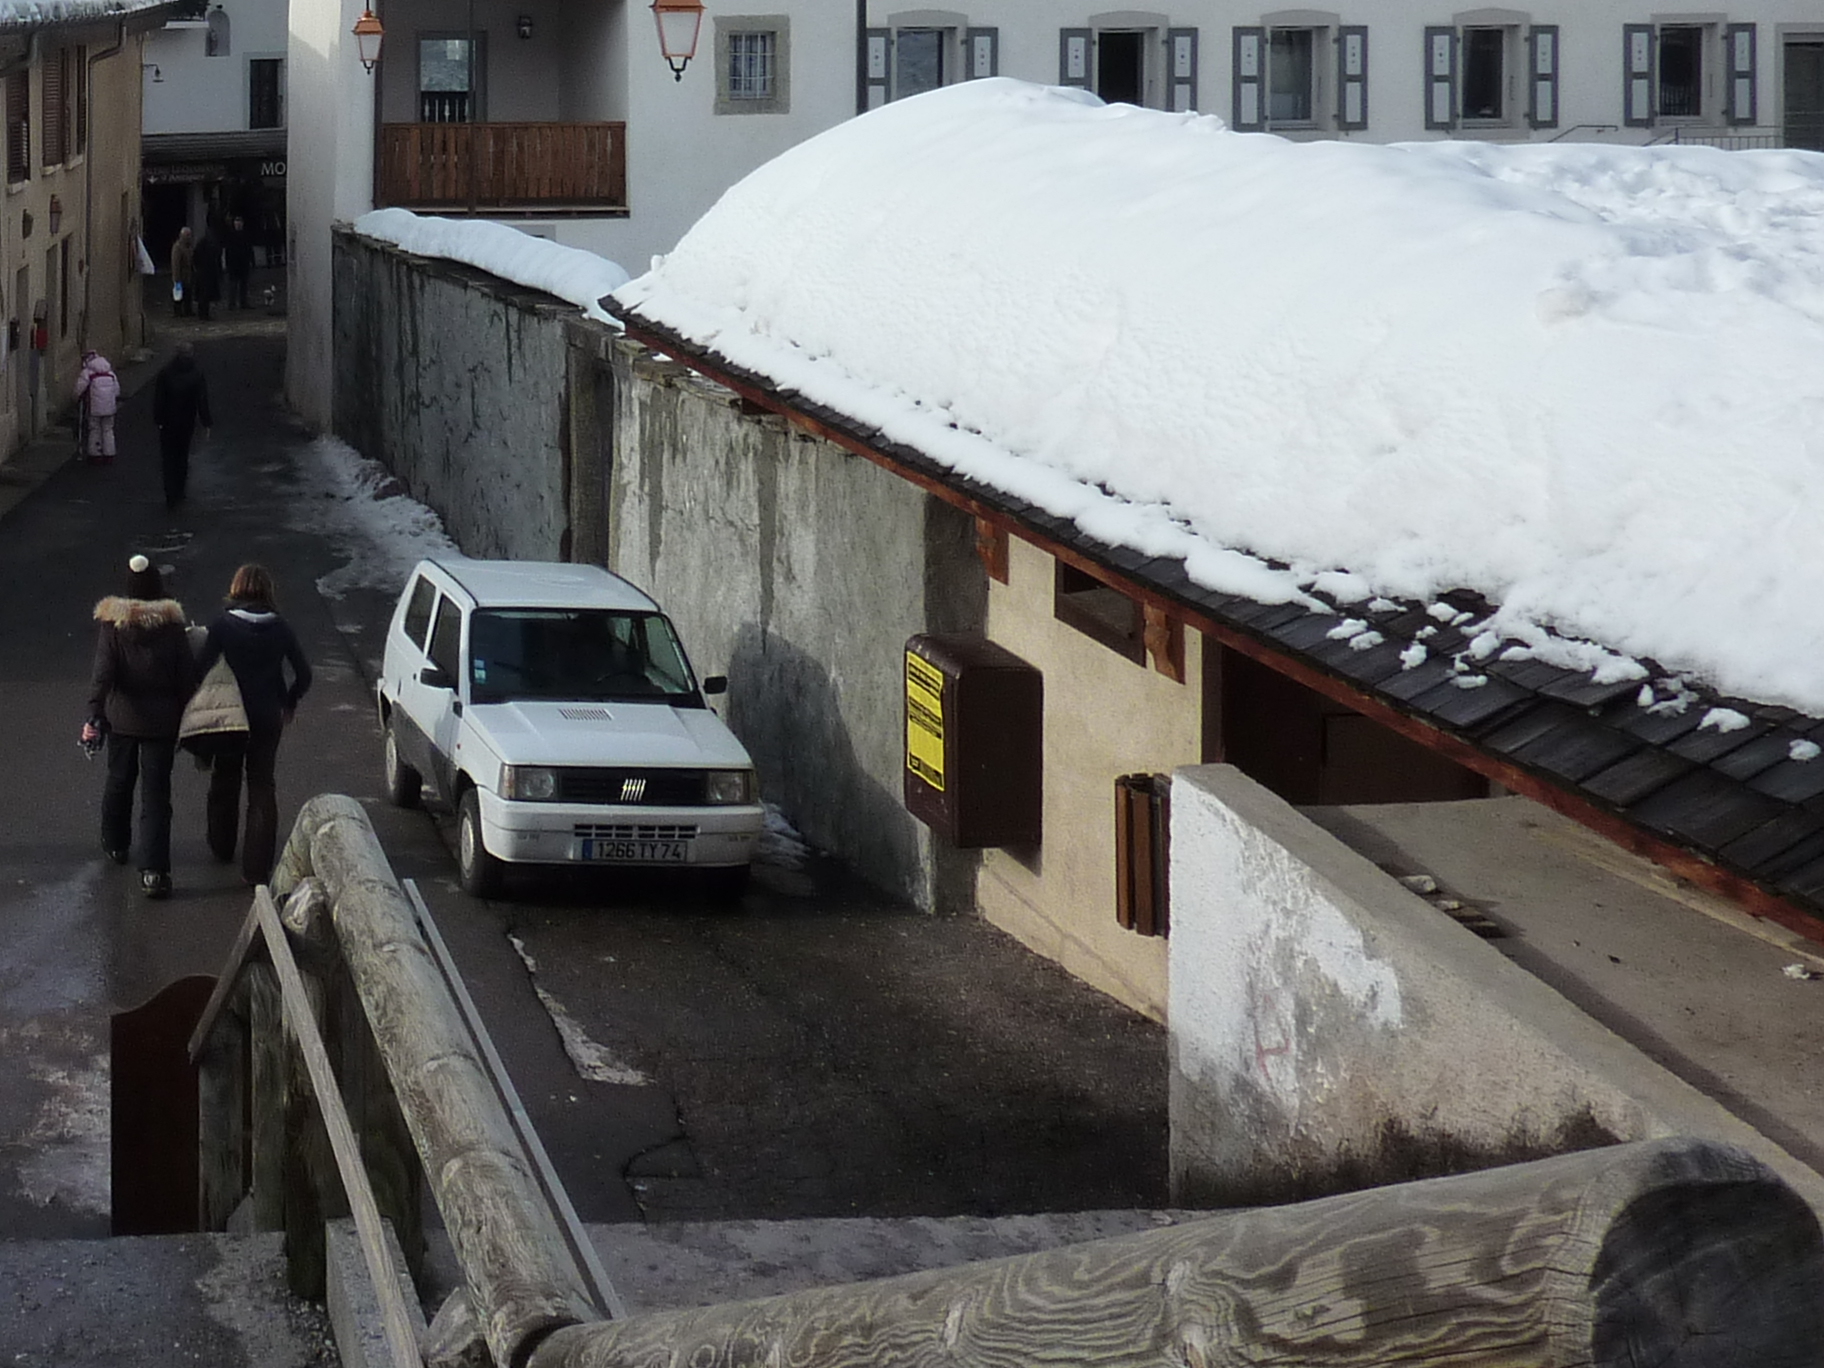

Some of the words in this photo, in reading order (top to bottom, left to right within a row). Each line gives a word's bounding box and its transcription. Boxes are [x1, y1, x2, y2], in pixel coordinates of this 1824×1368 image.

[598, 842, 636, 857] 1266
[637, 843, 658, 858] TY
[661, 843, 681, 858] 74
